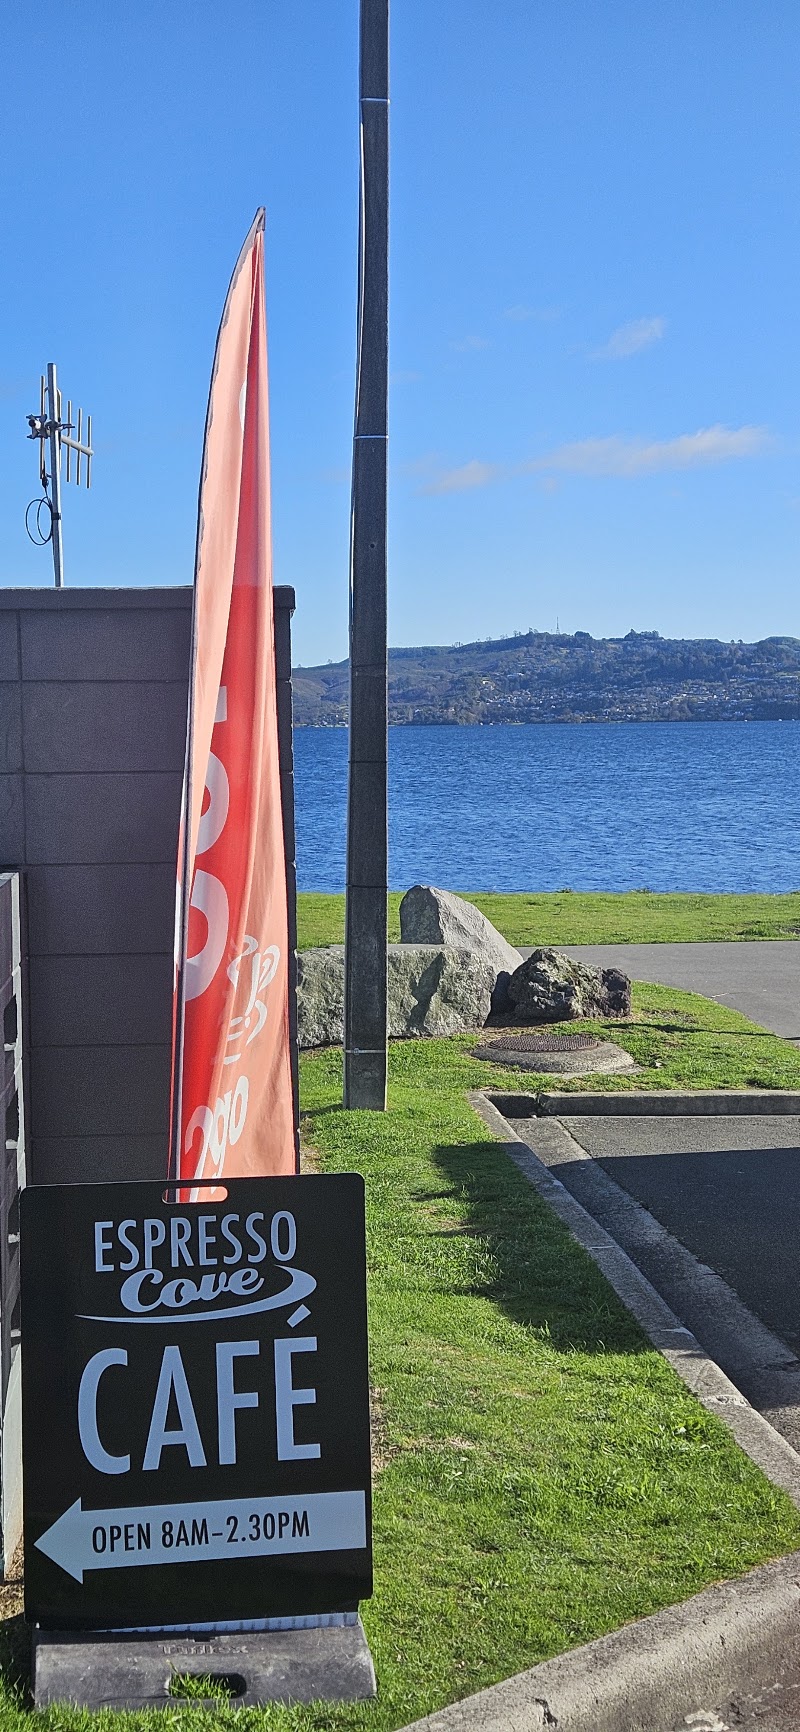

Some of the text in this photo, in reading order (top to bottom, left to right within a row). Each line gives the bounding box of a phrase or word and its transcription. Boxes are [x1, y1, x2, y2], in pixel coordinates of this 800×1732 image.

[94, 1210, 297, 1273] ESPRESSO
[120, 1268, 265, 1313] Cove
[77, 1304, 321, 1475] CAFÉ
[92, 1522, 151, 1554] OPEN
